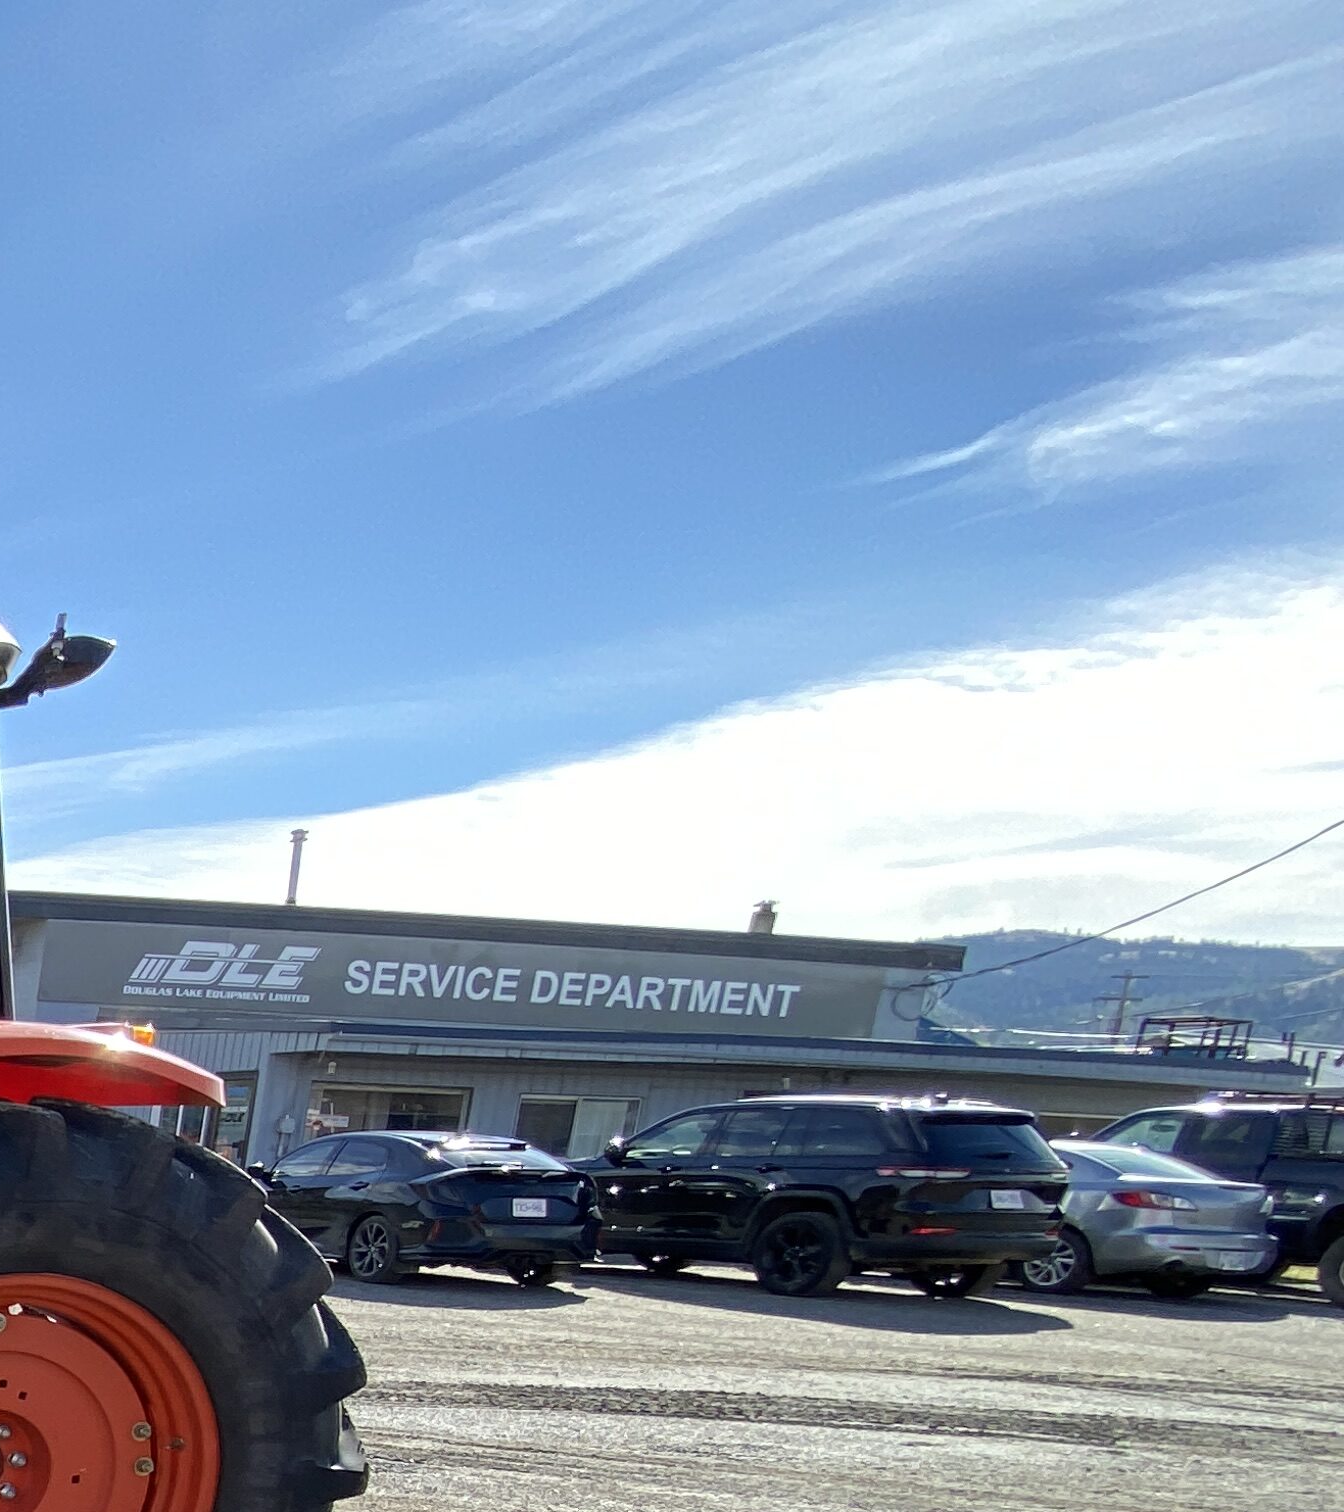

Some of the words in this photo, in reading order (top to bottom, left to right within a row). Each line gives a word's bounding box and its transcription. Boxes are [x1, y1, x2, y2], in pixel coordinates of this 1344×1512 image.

[160, 940, 322, 990] DLE
[344, 960, 522, 1002] SERVICE
[530, 970, 800, 1018] DEPARTMENT
[123, 985, 173, 996] DOUGLAS
[176, 988, 203, 997] LAKE
[206, 989, 266, 1001] EQUIPMENT
